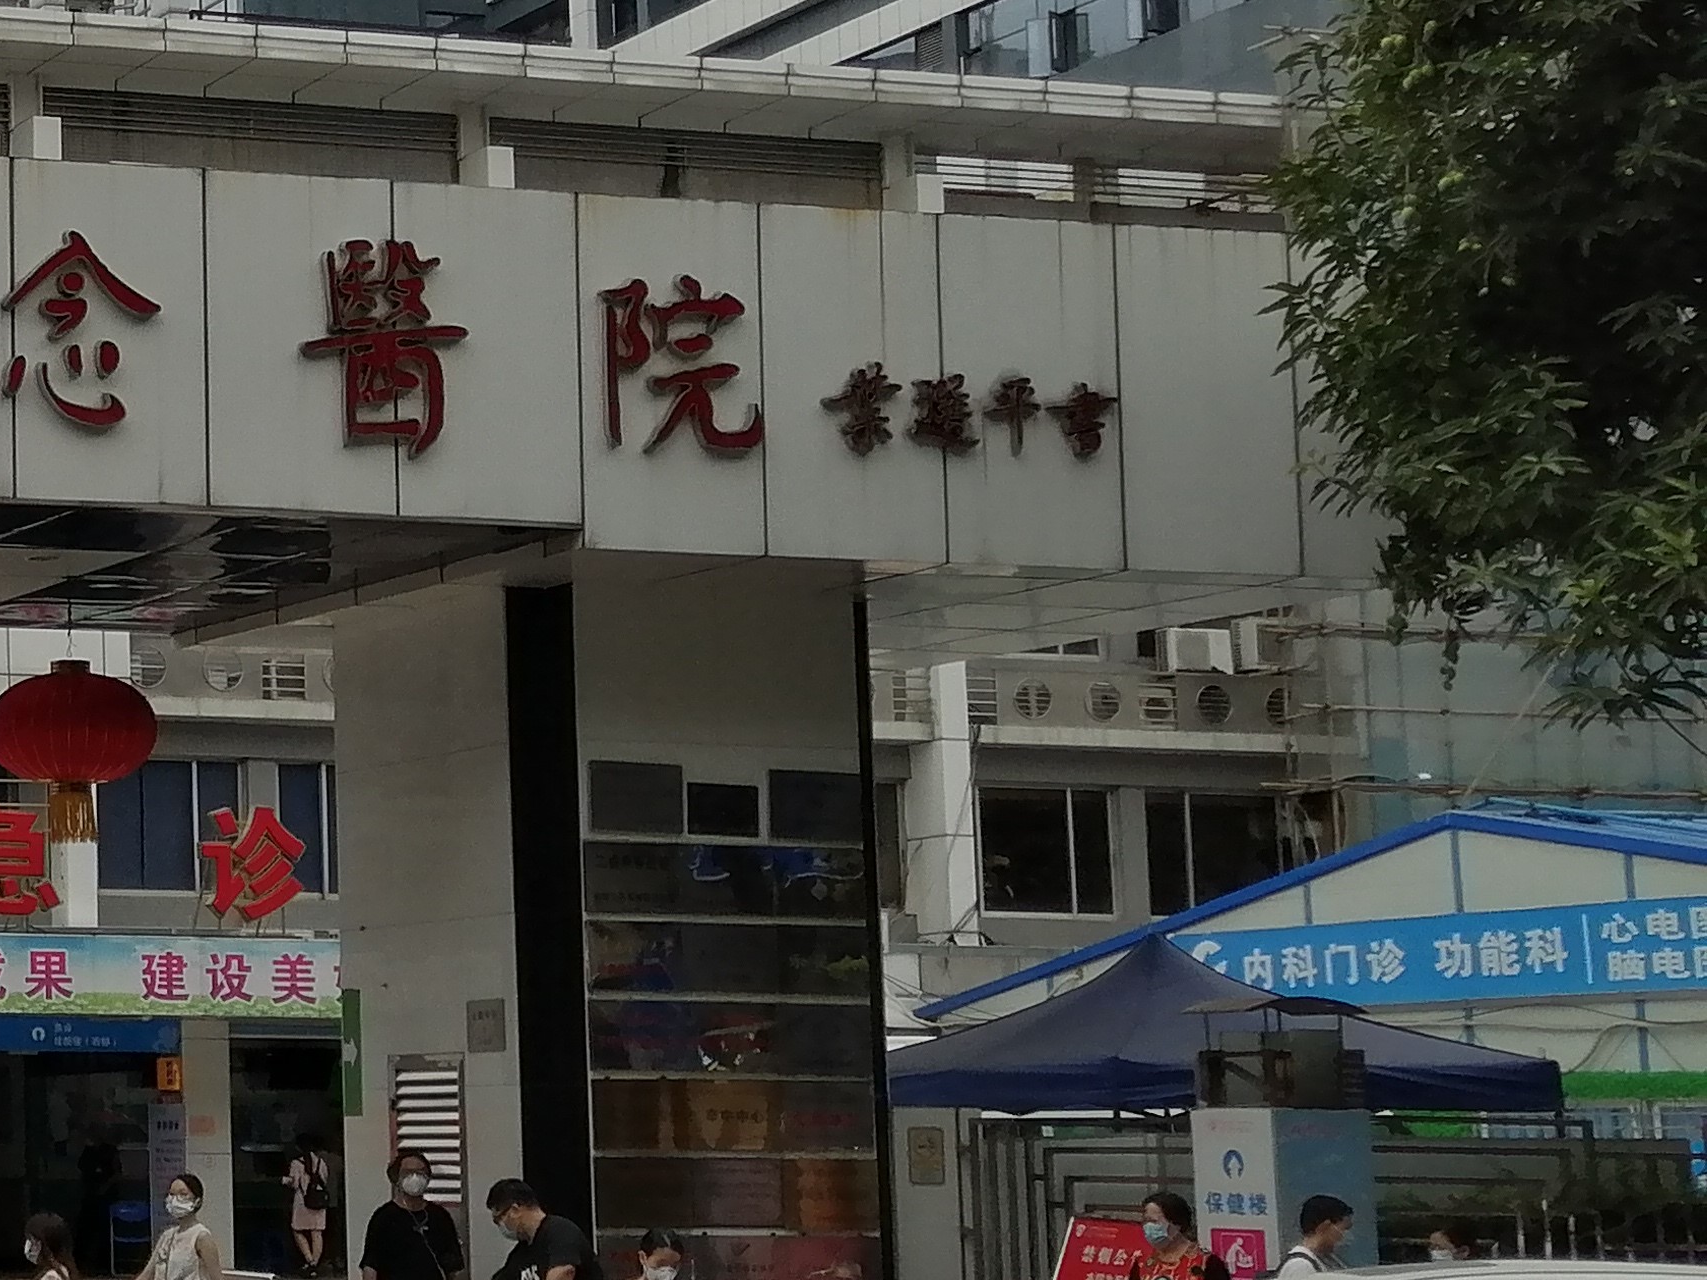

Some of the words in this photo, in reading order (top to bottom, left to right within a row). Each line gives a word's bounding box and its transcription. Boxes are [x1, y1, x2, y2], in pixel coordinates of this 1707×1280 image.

[142, 951, 342, 1005] 建设美
[1243, 938, 1406, 991] 内科门诊
[1433, 927, 1568, 978] 功能科
